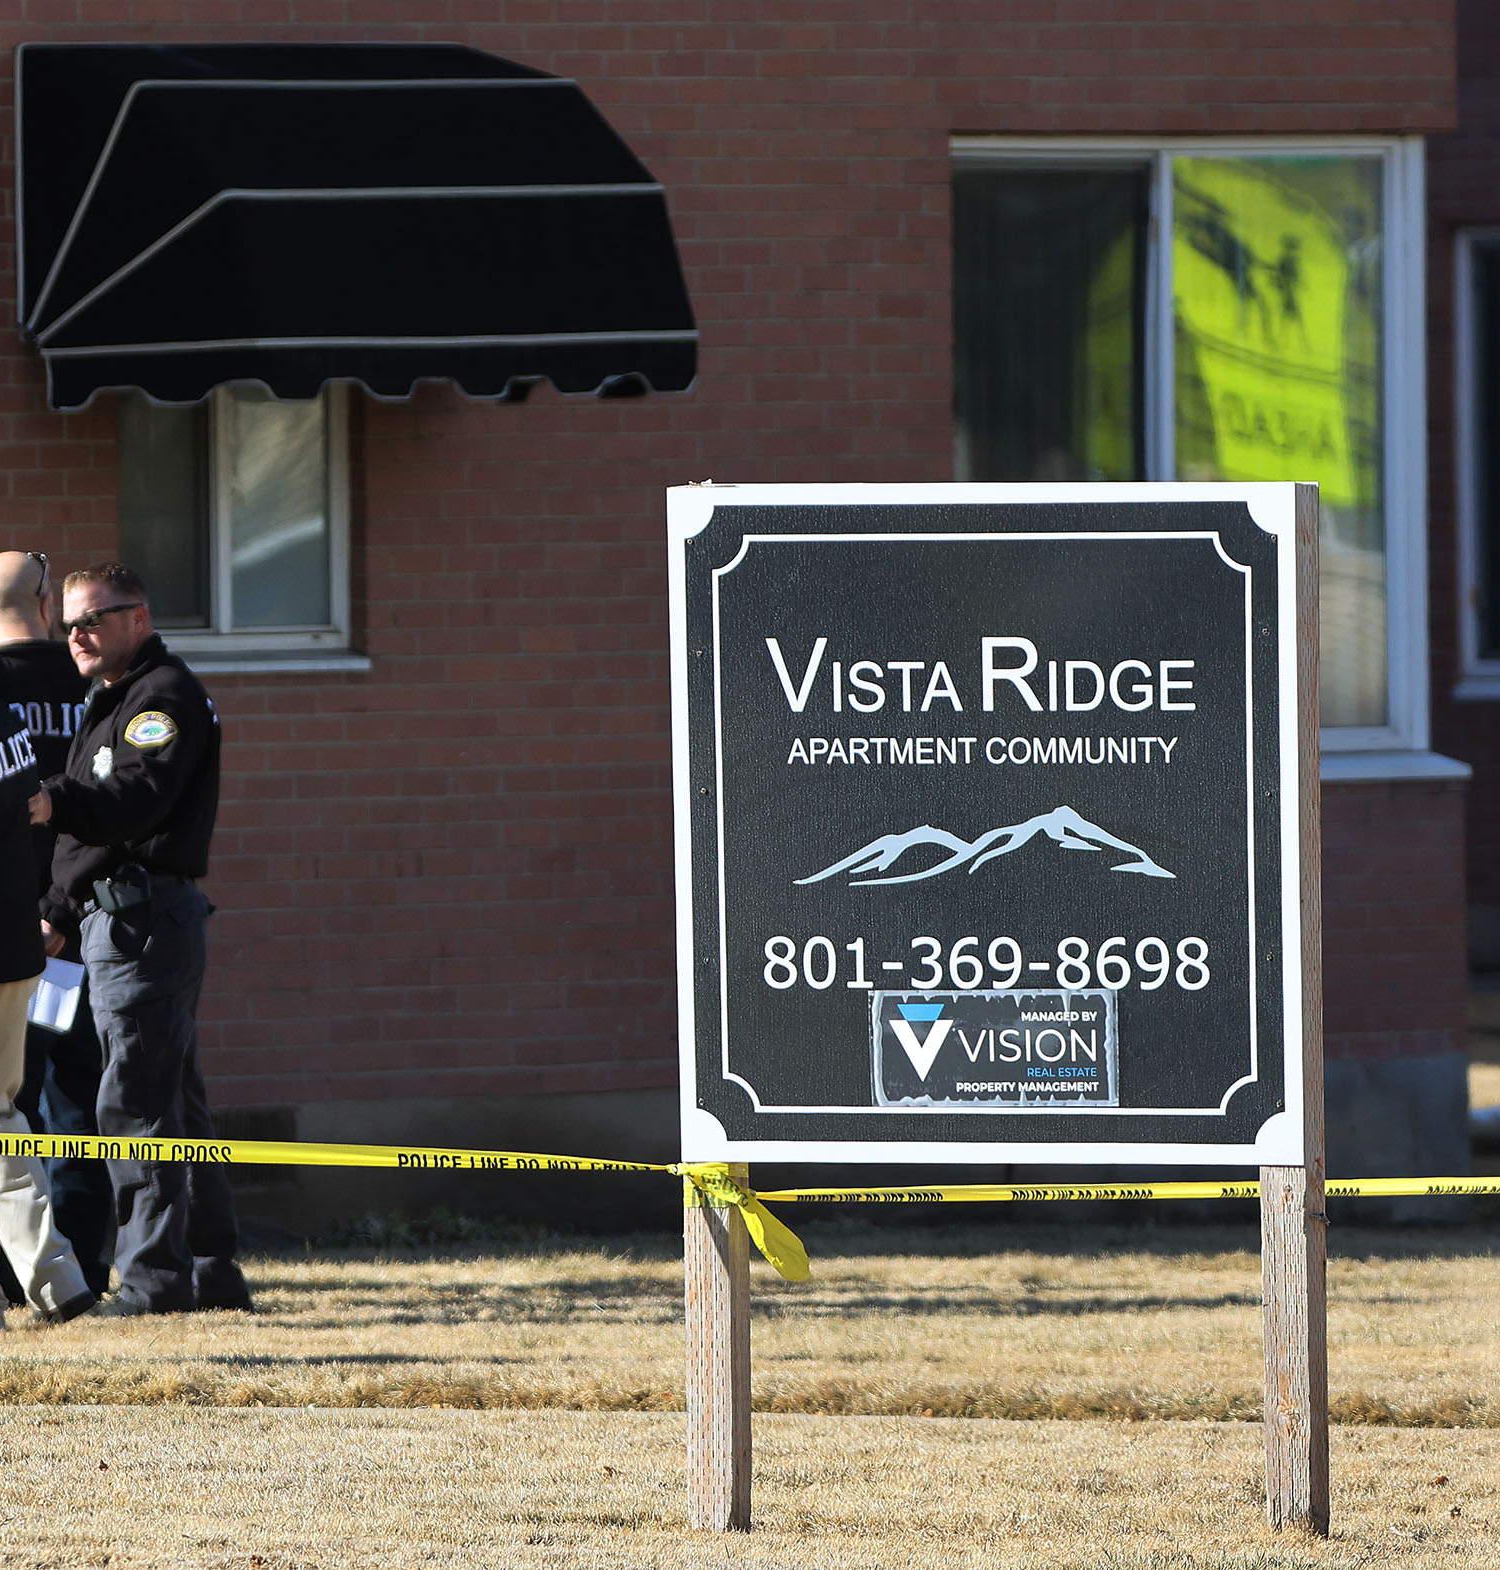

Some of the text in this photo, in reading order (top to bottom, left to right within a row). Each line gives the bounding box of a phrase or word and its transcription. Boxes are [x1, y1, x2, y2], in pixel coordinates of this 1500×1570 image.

[765, 636, 1197, 713] VISTA RIDGE
[787, 736, 1178, 765] APARTMENT COMMUNITY
[763, 936, 1211, 991] 801-369-8698
[1021, 1011, 1098, 1022] MANAGED BY
[957, 1028, 1097, 1063] VISION
[956, 1081, 1100, 1093] PROPERTY MANAGEMENT
[1027, 1067, 1098, 1078] REAL ESTATE
